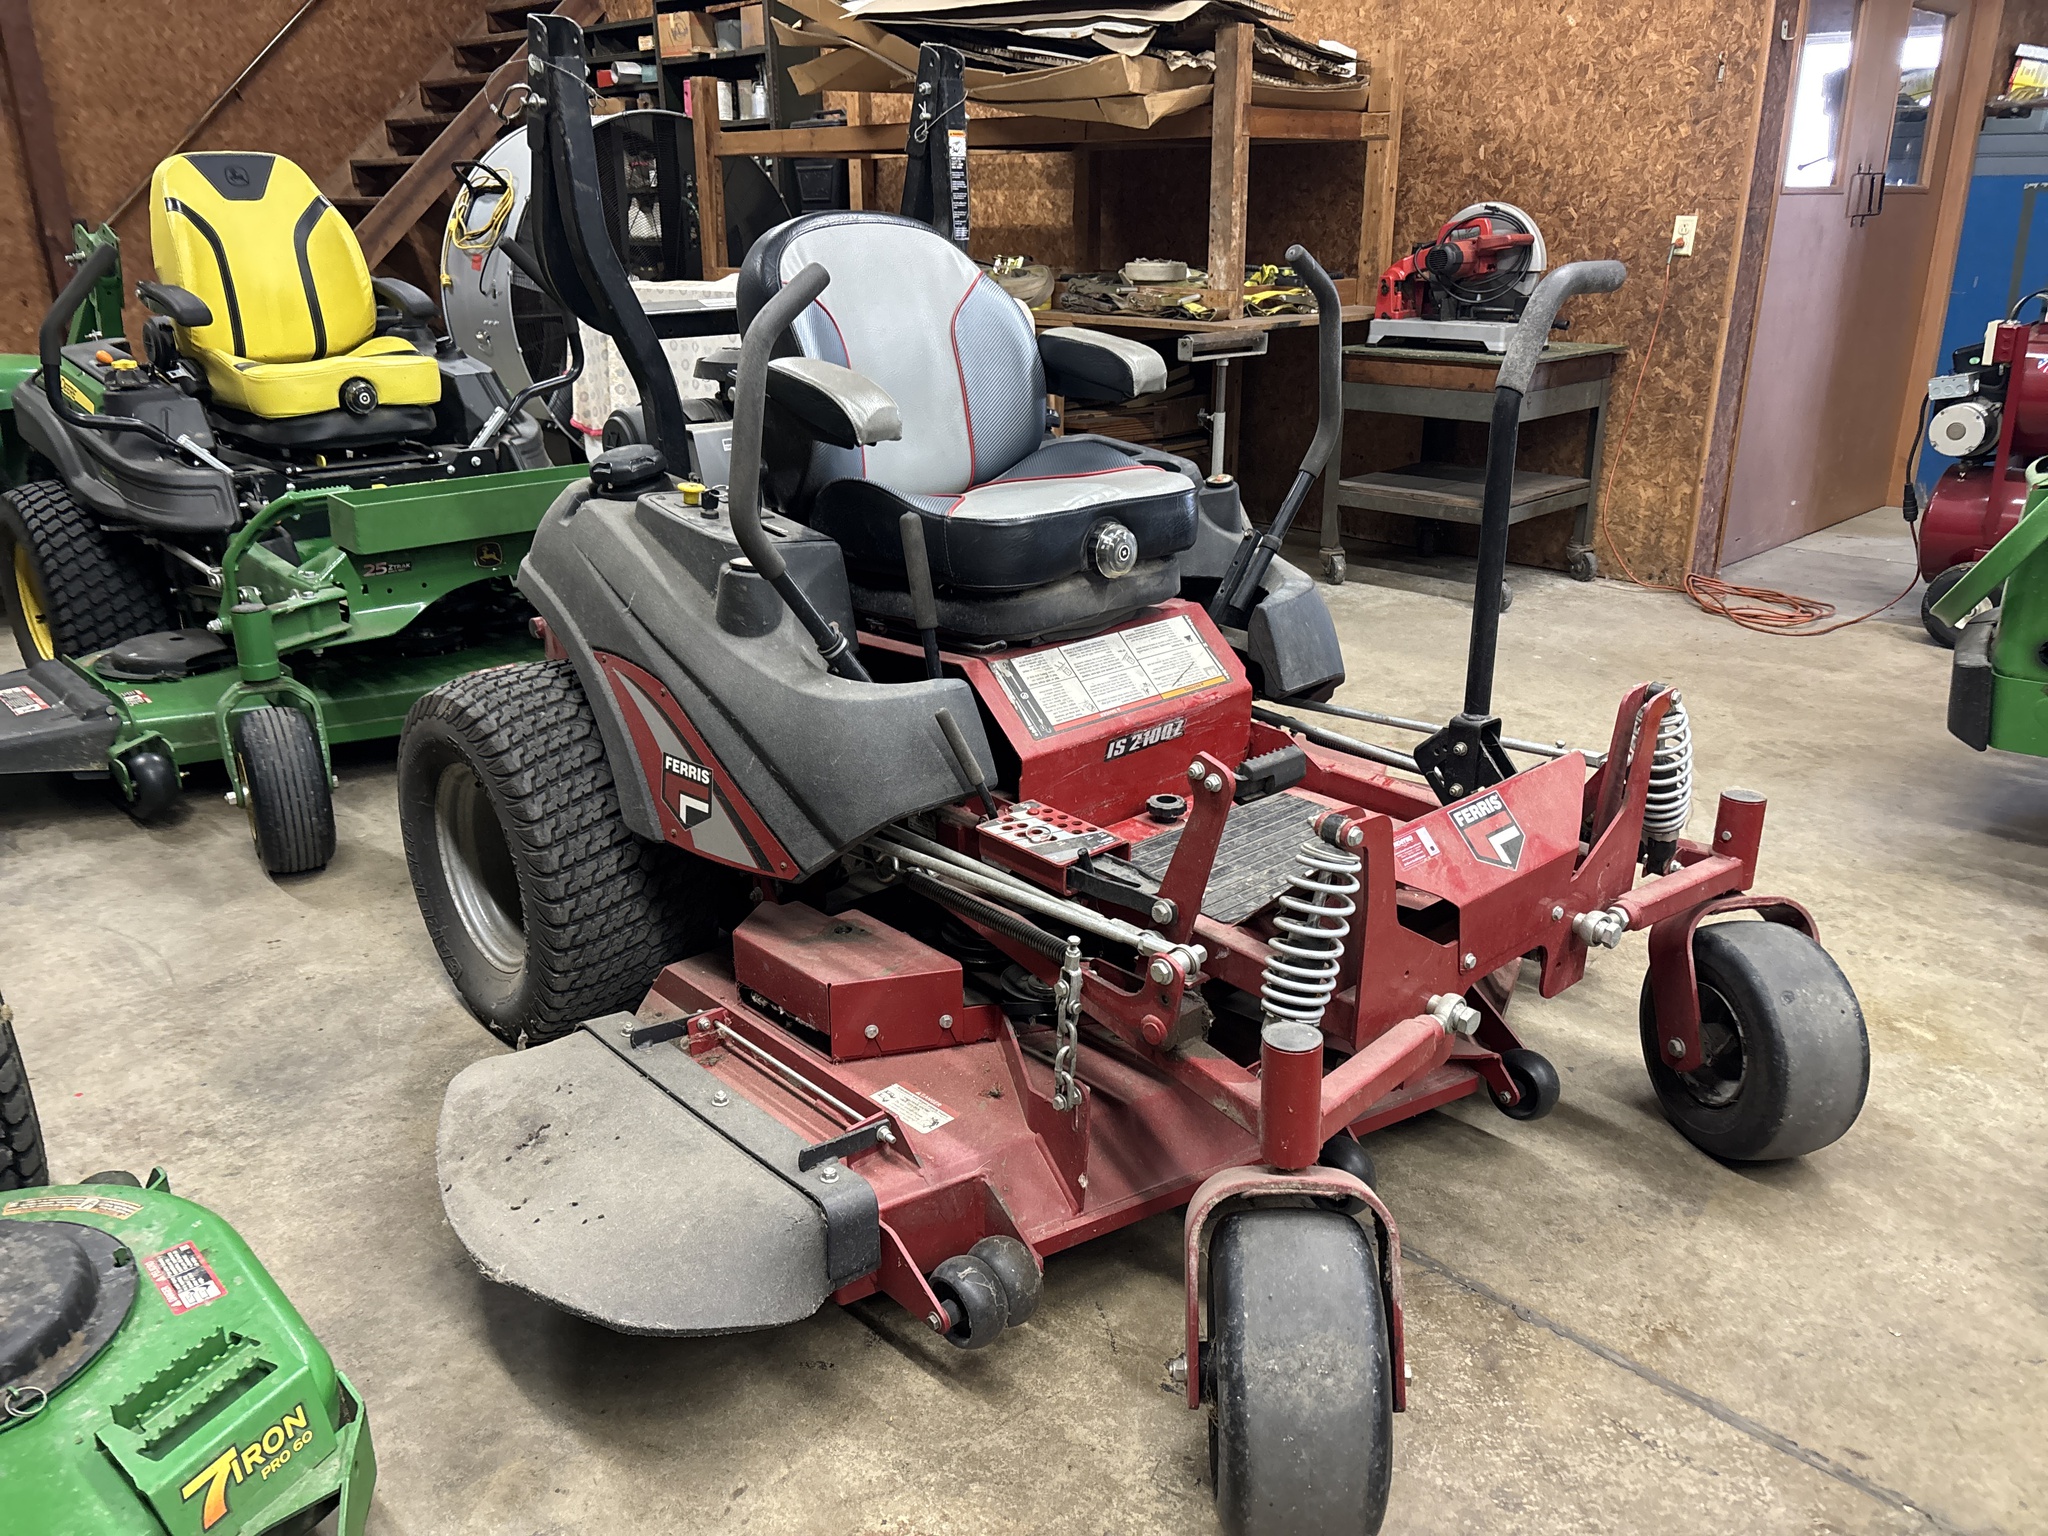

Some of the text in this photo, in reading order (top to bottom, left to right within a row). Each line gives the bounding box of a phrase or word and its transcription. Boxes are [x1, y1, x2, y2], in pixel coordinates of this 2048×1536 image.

[363, 562, 388, 577] 25
[1106, 719, 1186, 760] IS 2100Z
[665, 755, 710, 785] FERRIS
[1452, 795, 1503, 827] FERRIS
[230, 1404, 308, 1484] IRON
[260, 1430, 313, 1481] PRO 60
